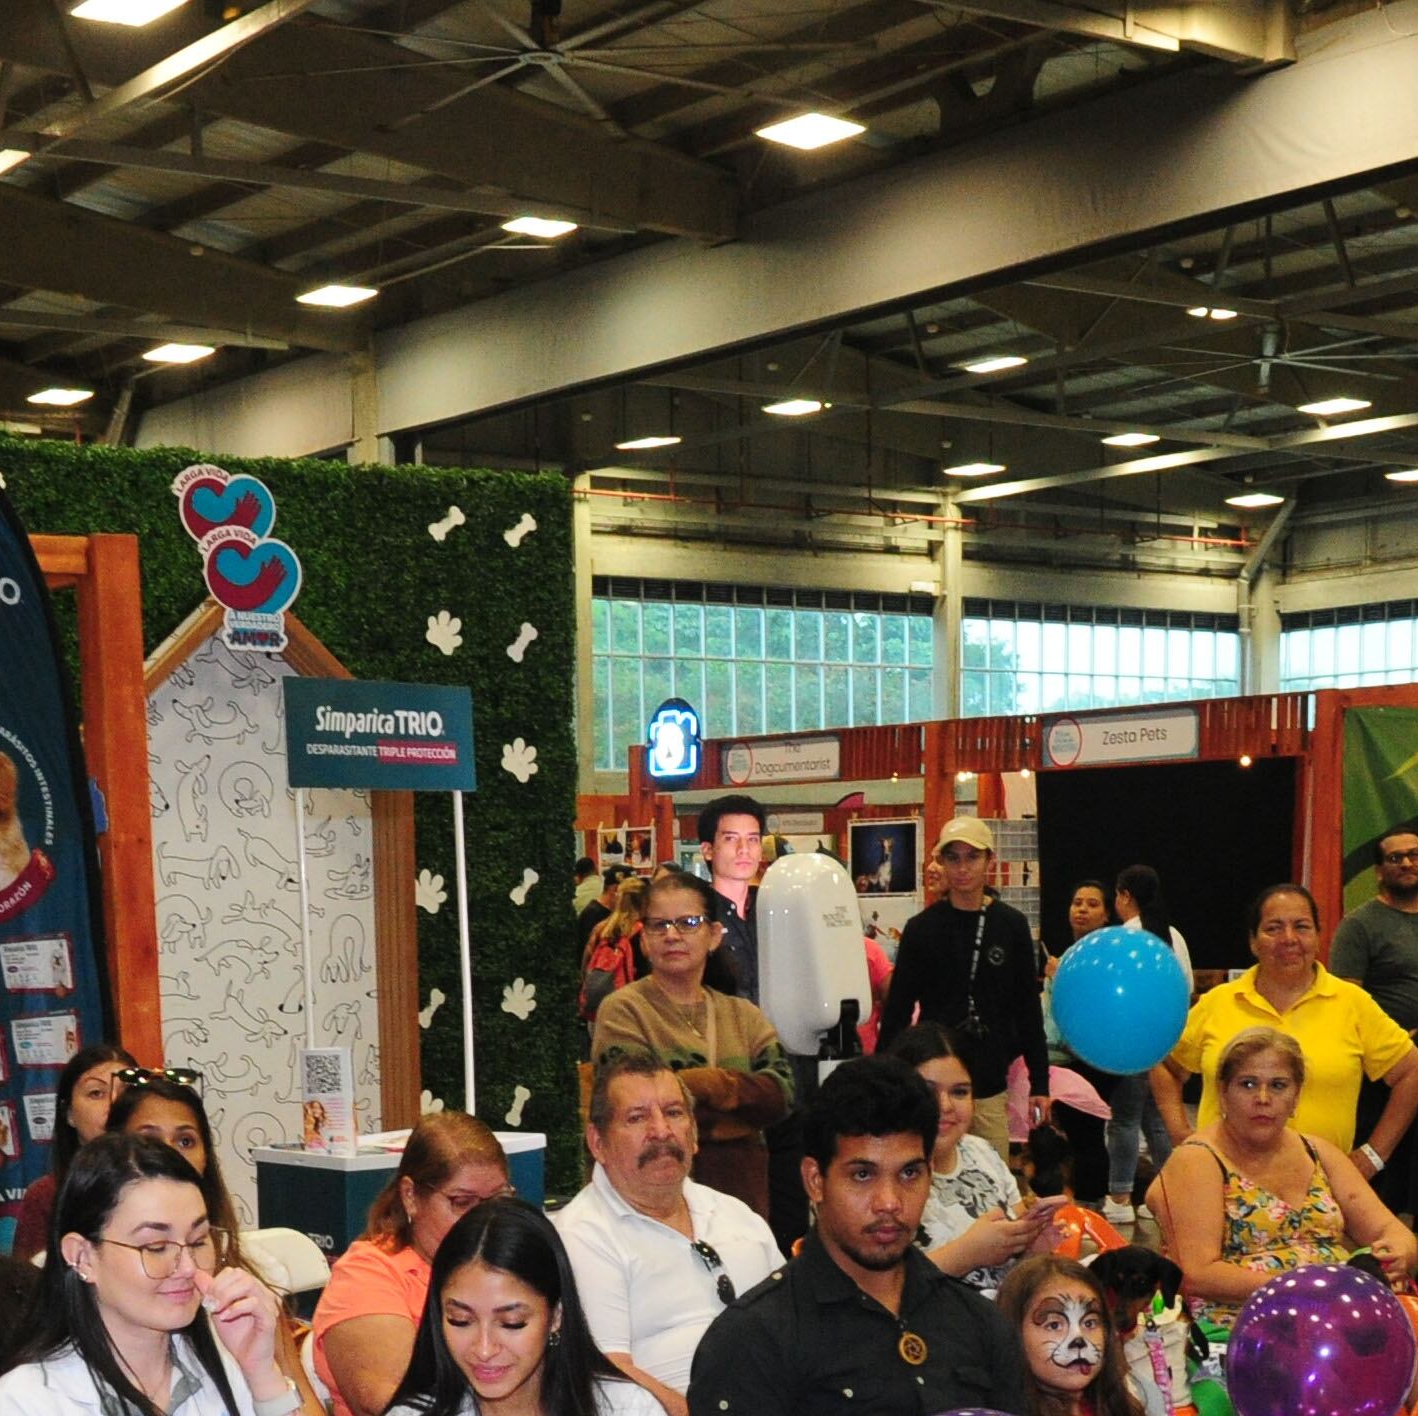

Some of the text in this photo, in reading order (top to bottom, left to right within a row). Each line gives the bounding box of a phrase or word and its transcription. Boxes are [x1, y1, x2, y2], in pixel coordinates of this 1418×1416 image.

[177, 467, 229, 492] LARGA VIDA
[203, 528, 257, 552] LARGA VIDA
[1102, 727, 1168, 746] Zesta Pets
[34, 767, 54, 846] INTESTINALES
